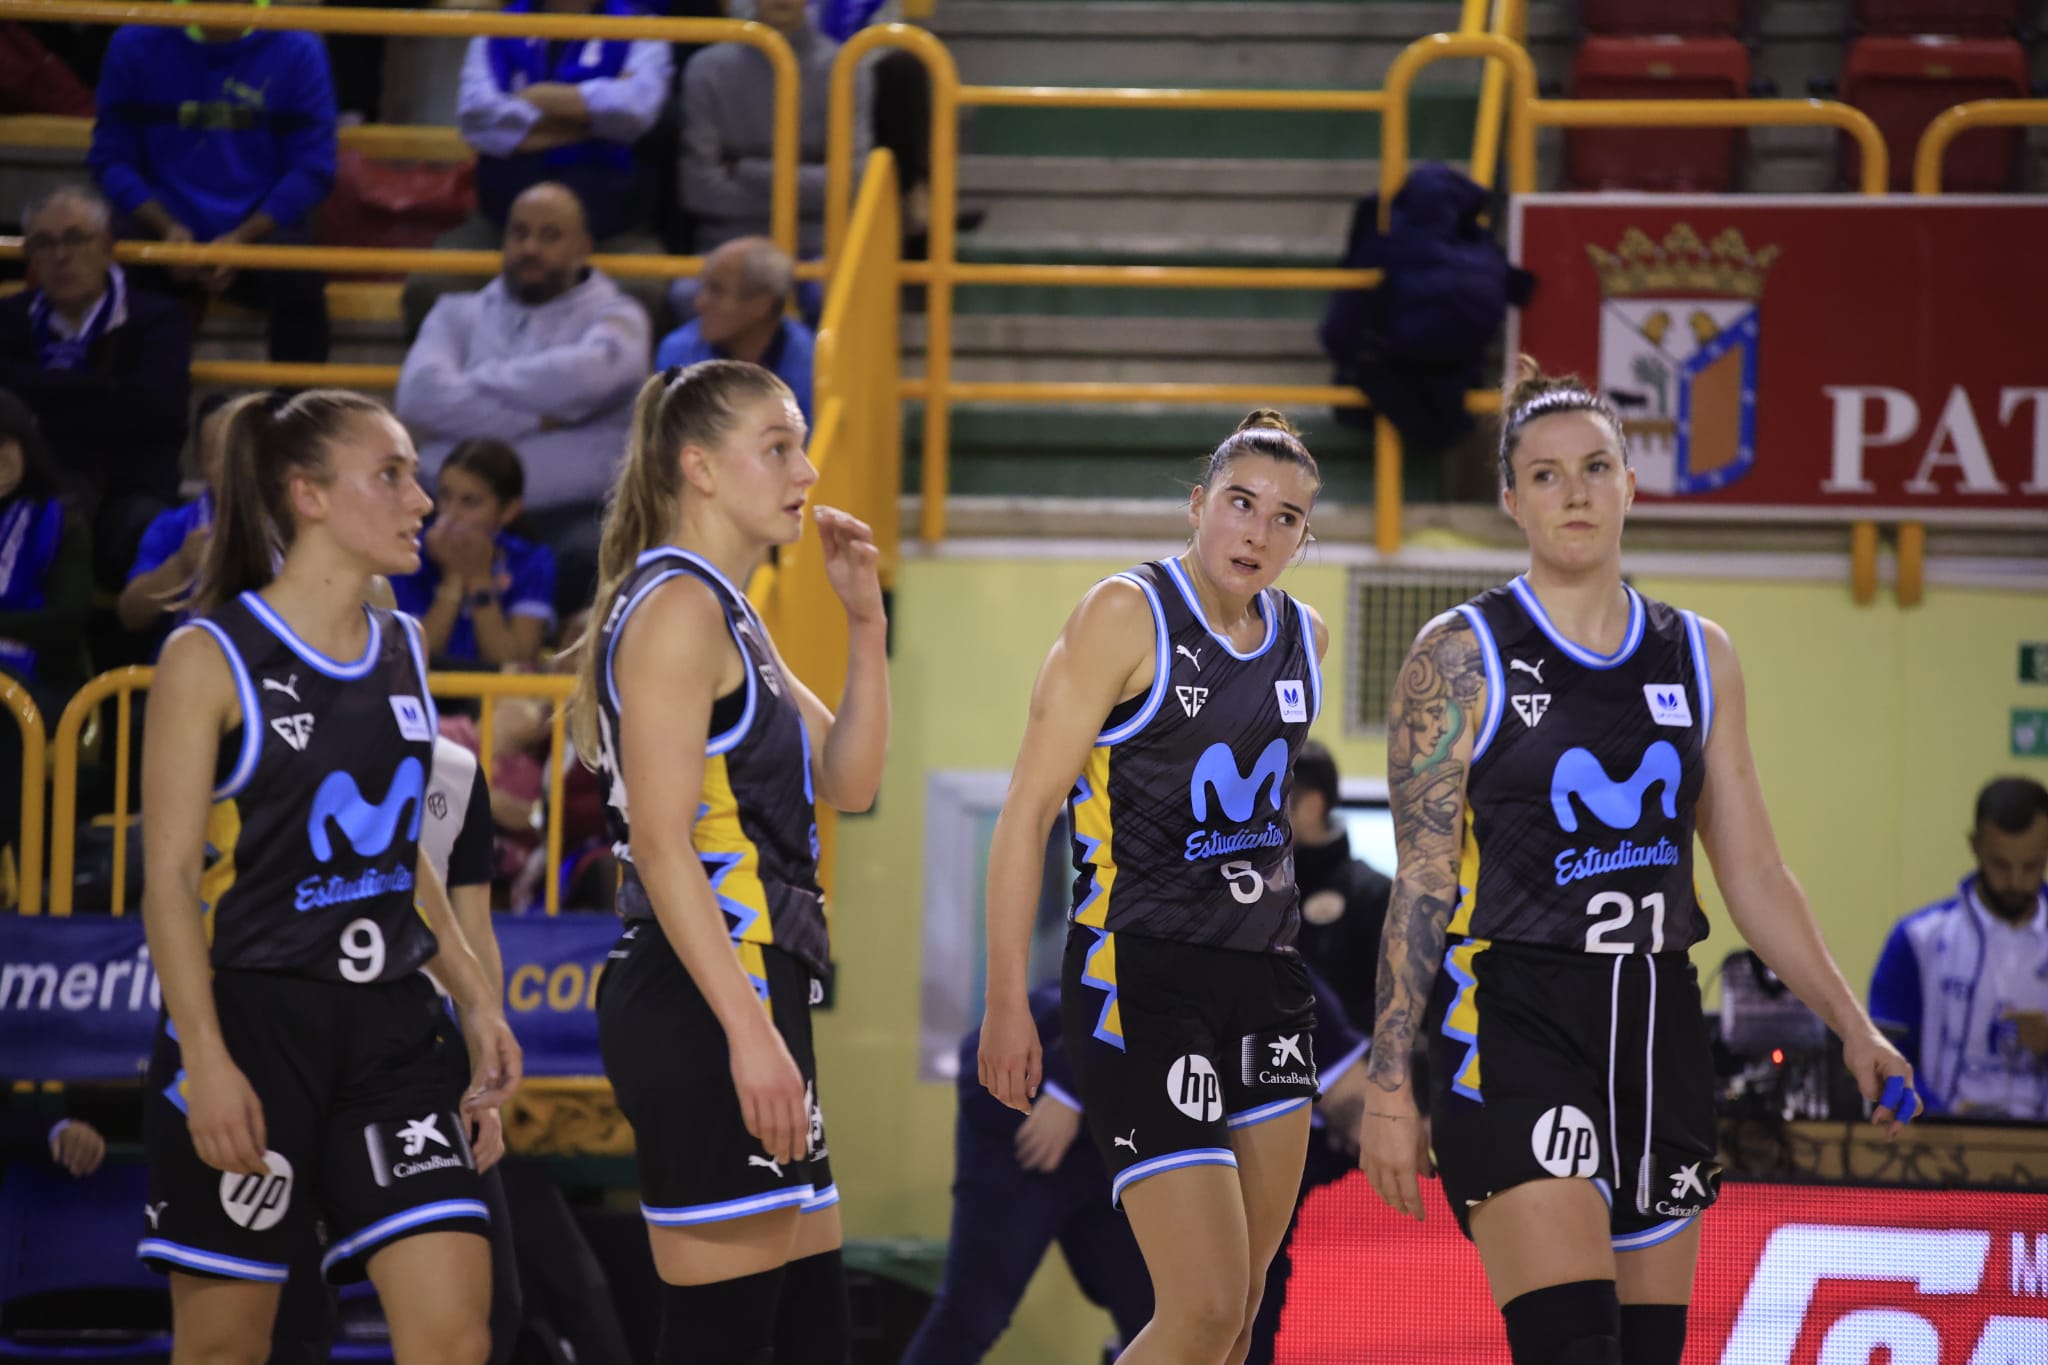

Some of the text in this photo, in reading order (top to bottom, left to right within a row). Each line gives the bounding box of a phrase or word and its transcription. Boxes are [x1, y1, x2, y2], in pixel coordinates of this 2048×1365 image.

[1820, 384, 2048, 494] PAT
[1184, 821, 1284, 861] Estudiantes
[1554, 836, 1679, 886] Estudiantes
[1220, 860, 1264, 904] 5
[338, 917, 386, 983] 9
[1584, 890, 1665, 954] 21
[1179, 1055, 1217, 1121] hp
[1259, 1071, 1312, 1086] CaixaBank
[1544, 1105, 1592, 1177] hp
